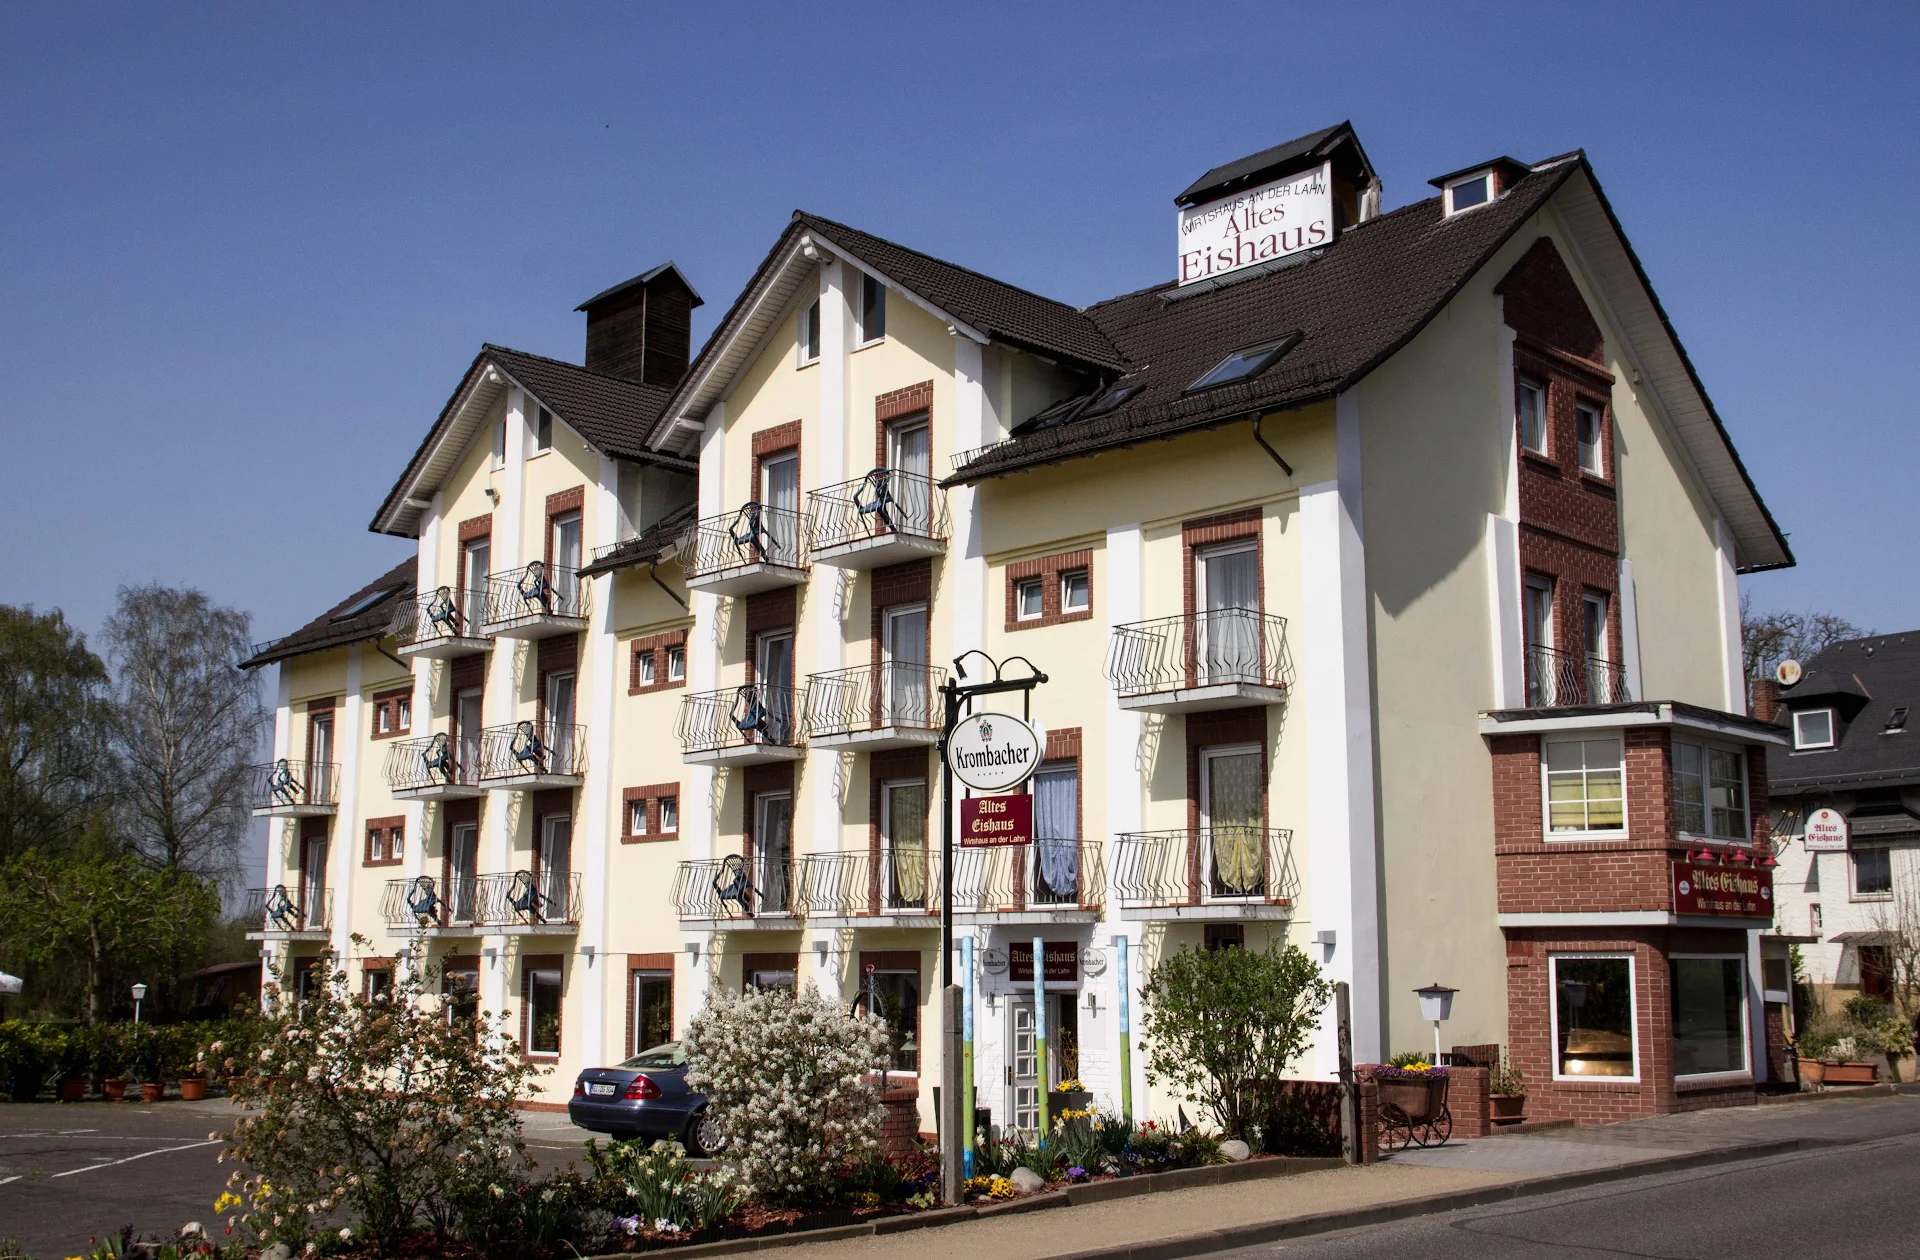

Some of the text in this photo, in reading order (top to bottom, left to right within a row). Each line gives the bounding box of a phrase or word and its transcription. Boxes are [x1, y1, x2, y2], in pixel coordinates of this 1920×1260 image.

[1181, 184, 1326, 236] WIRTSHAUS AN DER LAHN
[1222, 203, 1285, 239] Altes
[1179, 220, 1326, 284] Eishaus
[956, 742, 1030, 769] Krombacher
[979, 800, 1006, 814] Altes
[972, 818, 1014, 834] Eishaus
[1809, 833, 1843, 843] Eishaus
[1692, 870, 1758, 896] Altes Eishaus
[1697, 898, 1724, 910] Wirtshaus
[1725, 901, 1732, 909] an
[1743, 900, 1756, 911] Lahn
[1012, 950, 1076, 964] Altes ishaus
